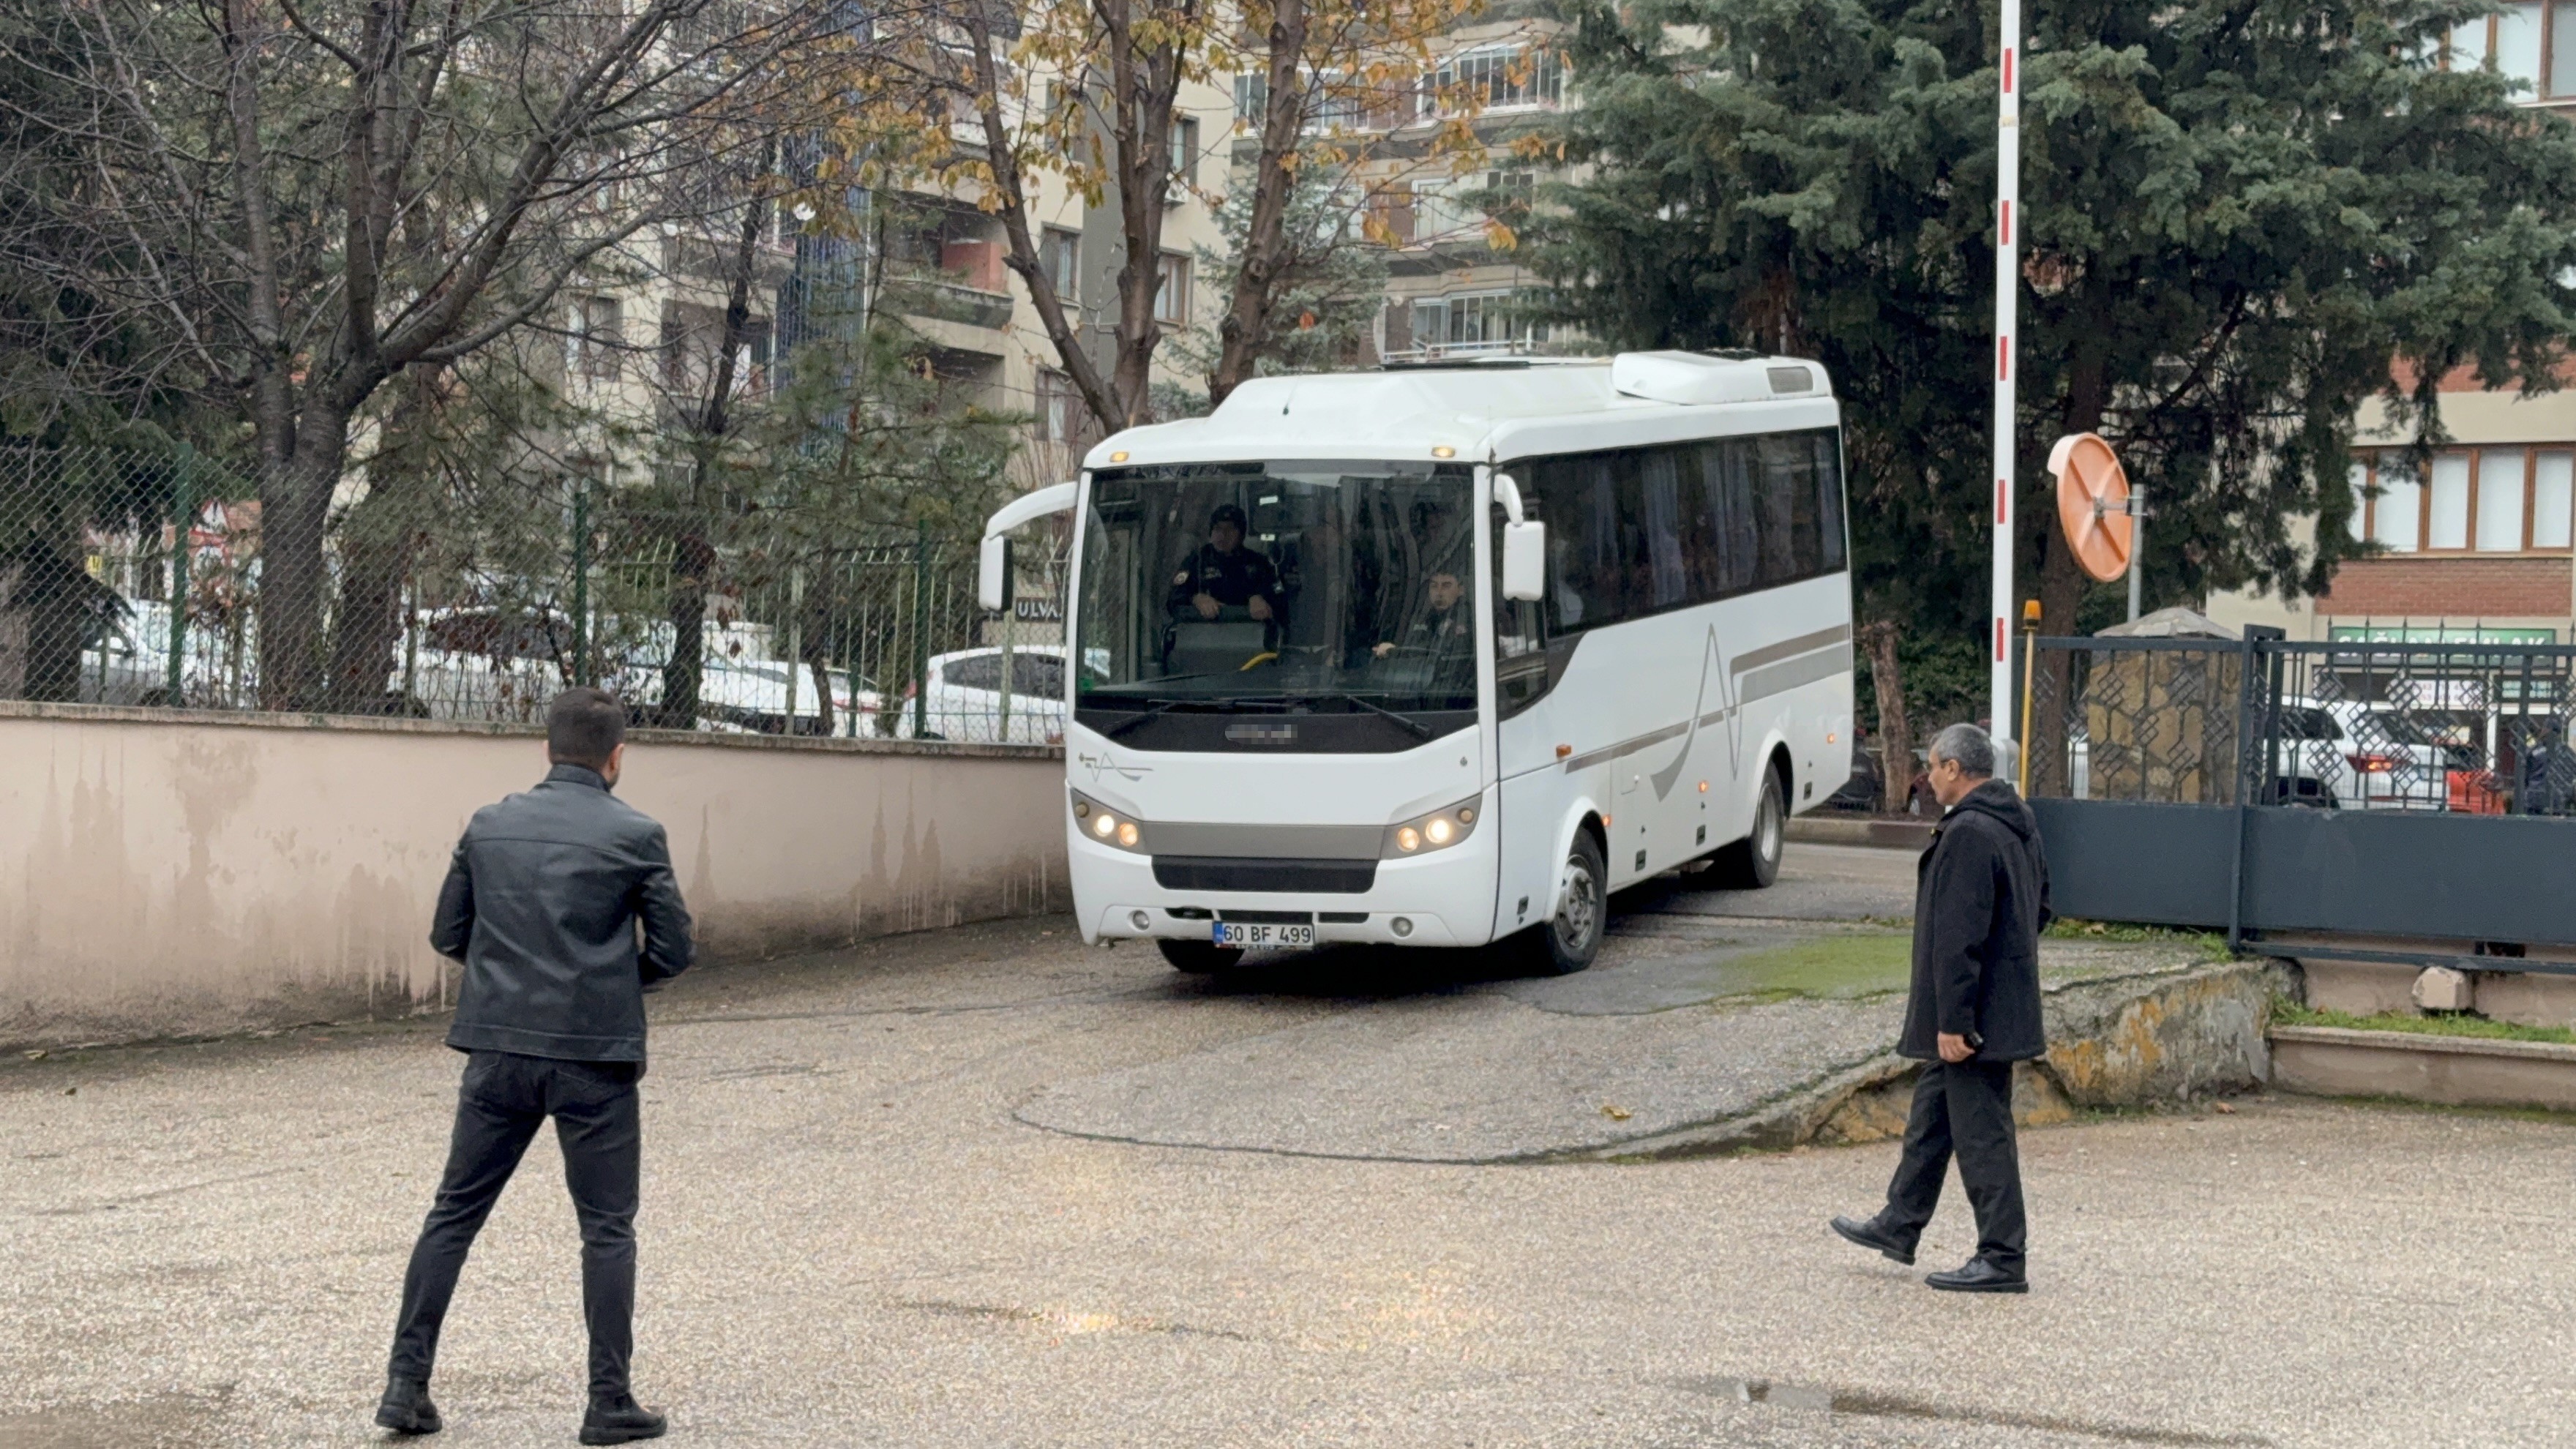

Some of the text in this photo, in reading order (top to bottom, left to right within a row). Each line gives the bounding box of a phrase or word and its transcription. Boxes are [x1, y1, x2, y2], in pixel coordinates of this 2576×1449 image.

[1224, 925, 1311, 943] 60 BF 499
